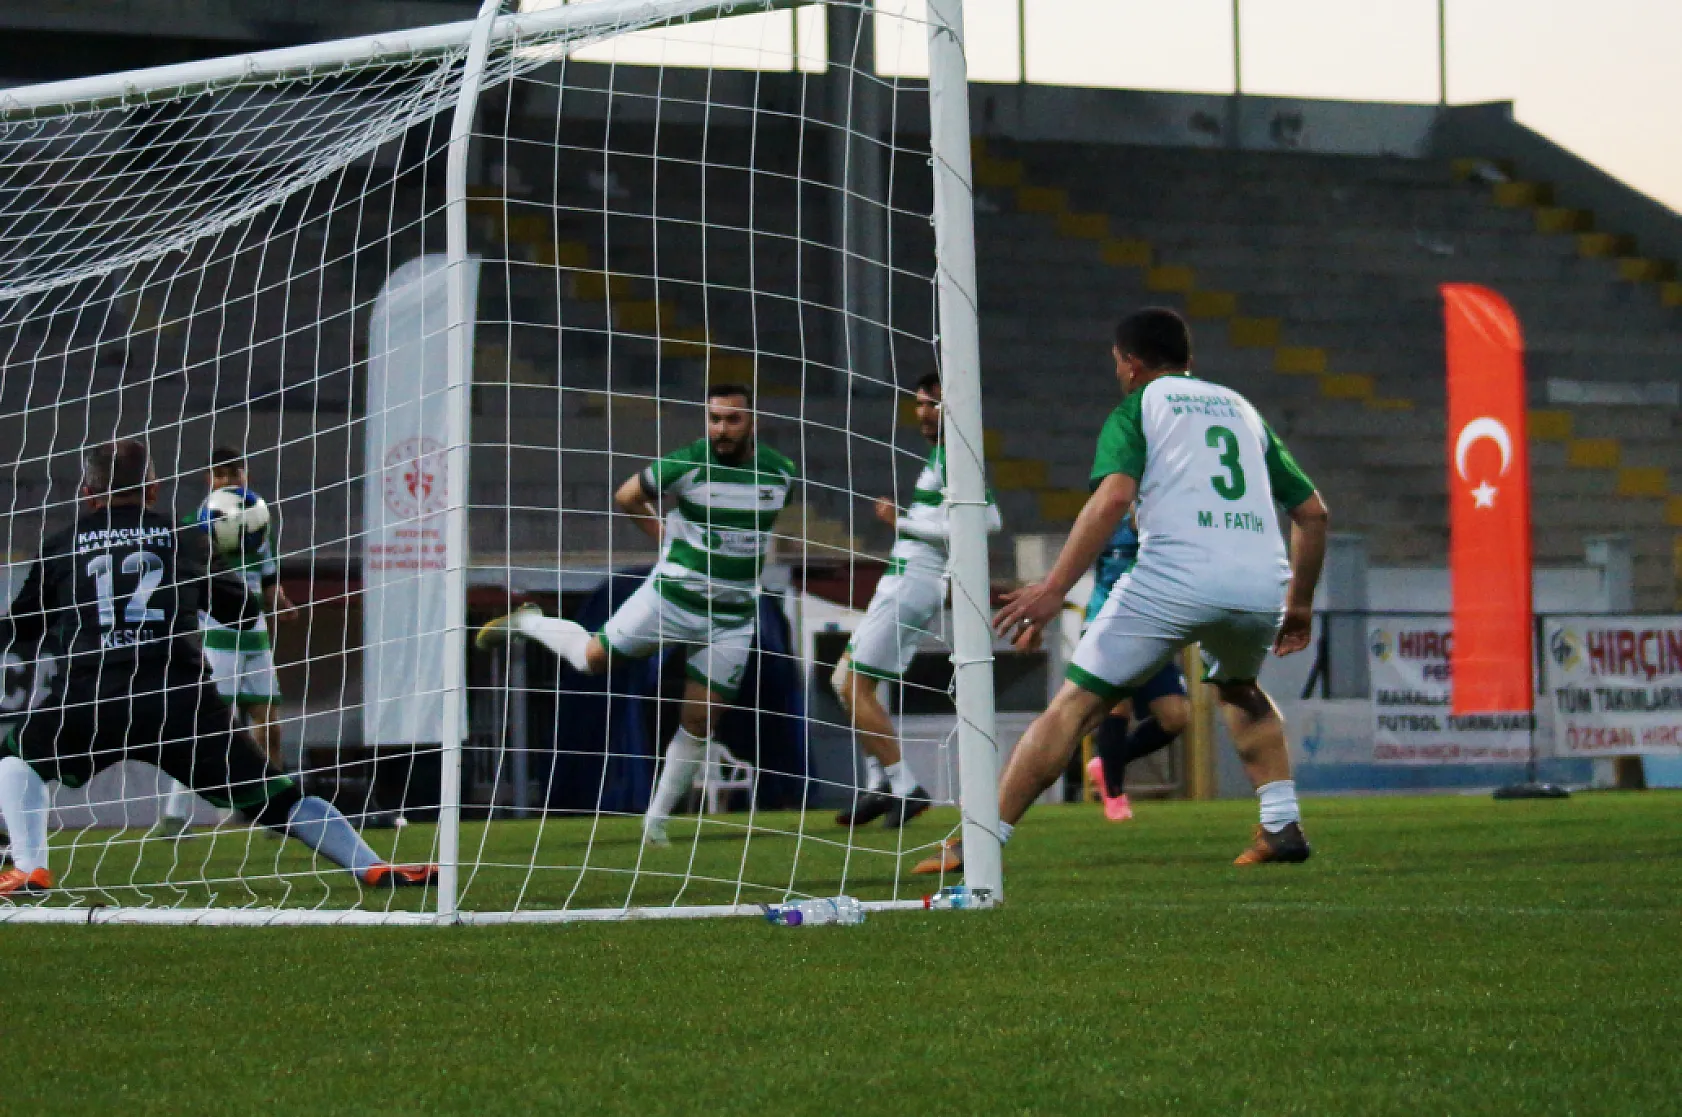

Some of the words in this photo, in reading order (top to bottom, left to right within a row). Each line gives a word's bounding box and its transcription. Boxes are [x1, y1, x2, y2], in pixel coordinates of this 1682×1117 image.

[1205, 425, 1246, 500] 3
[78, 527, 171, 544] KARAÇULHA
[1198, 510, 1219, 528] M.
[1223, 510, 1264, 534] FATİH
[87, 551, 165, 626] 12
[1398, 631, 1453, 663] HIRÇ
[1378, 714, 1441, 732] FUTBOL
